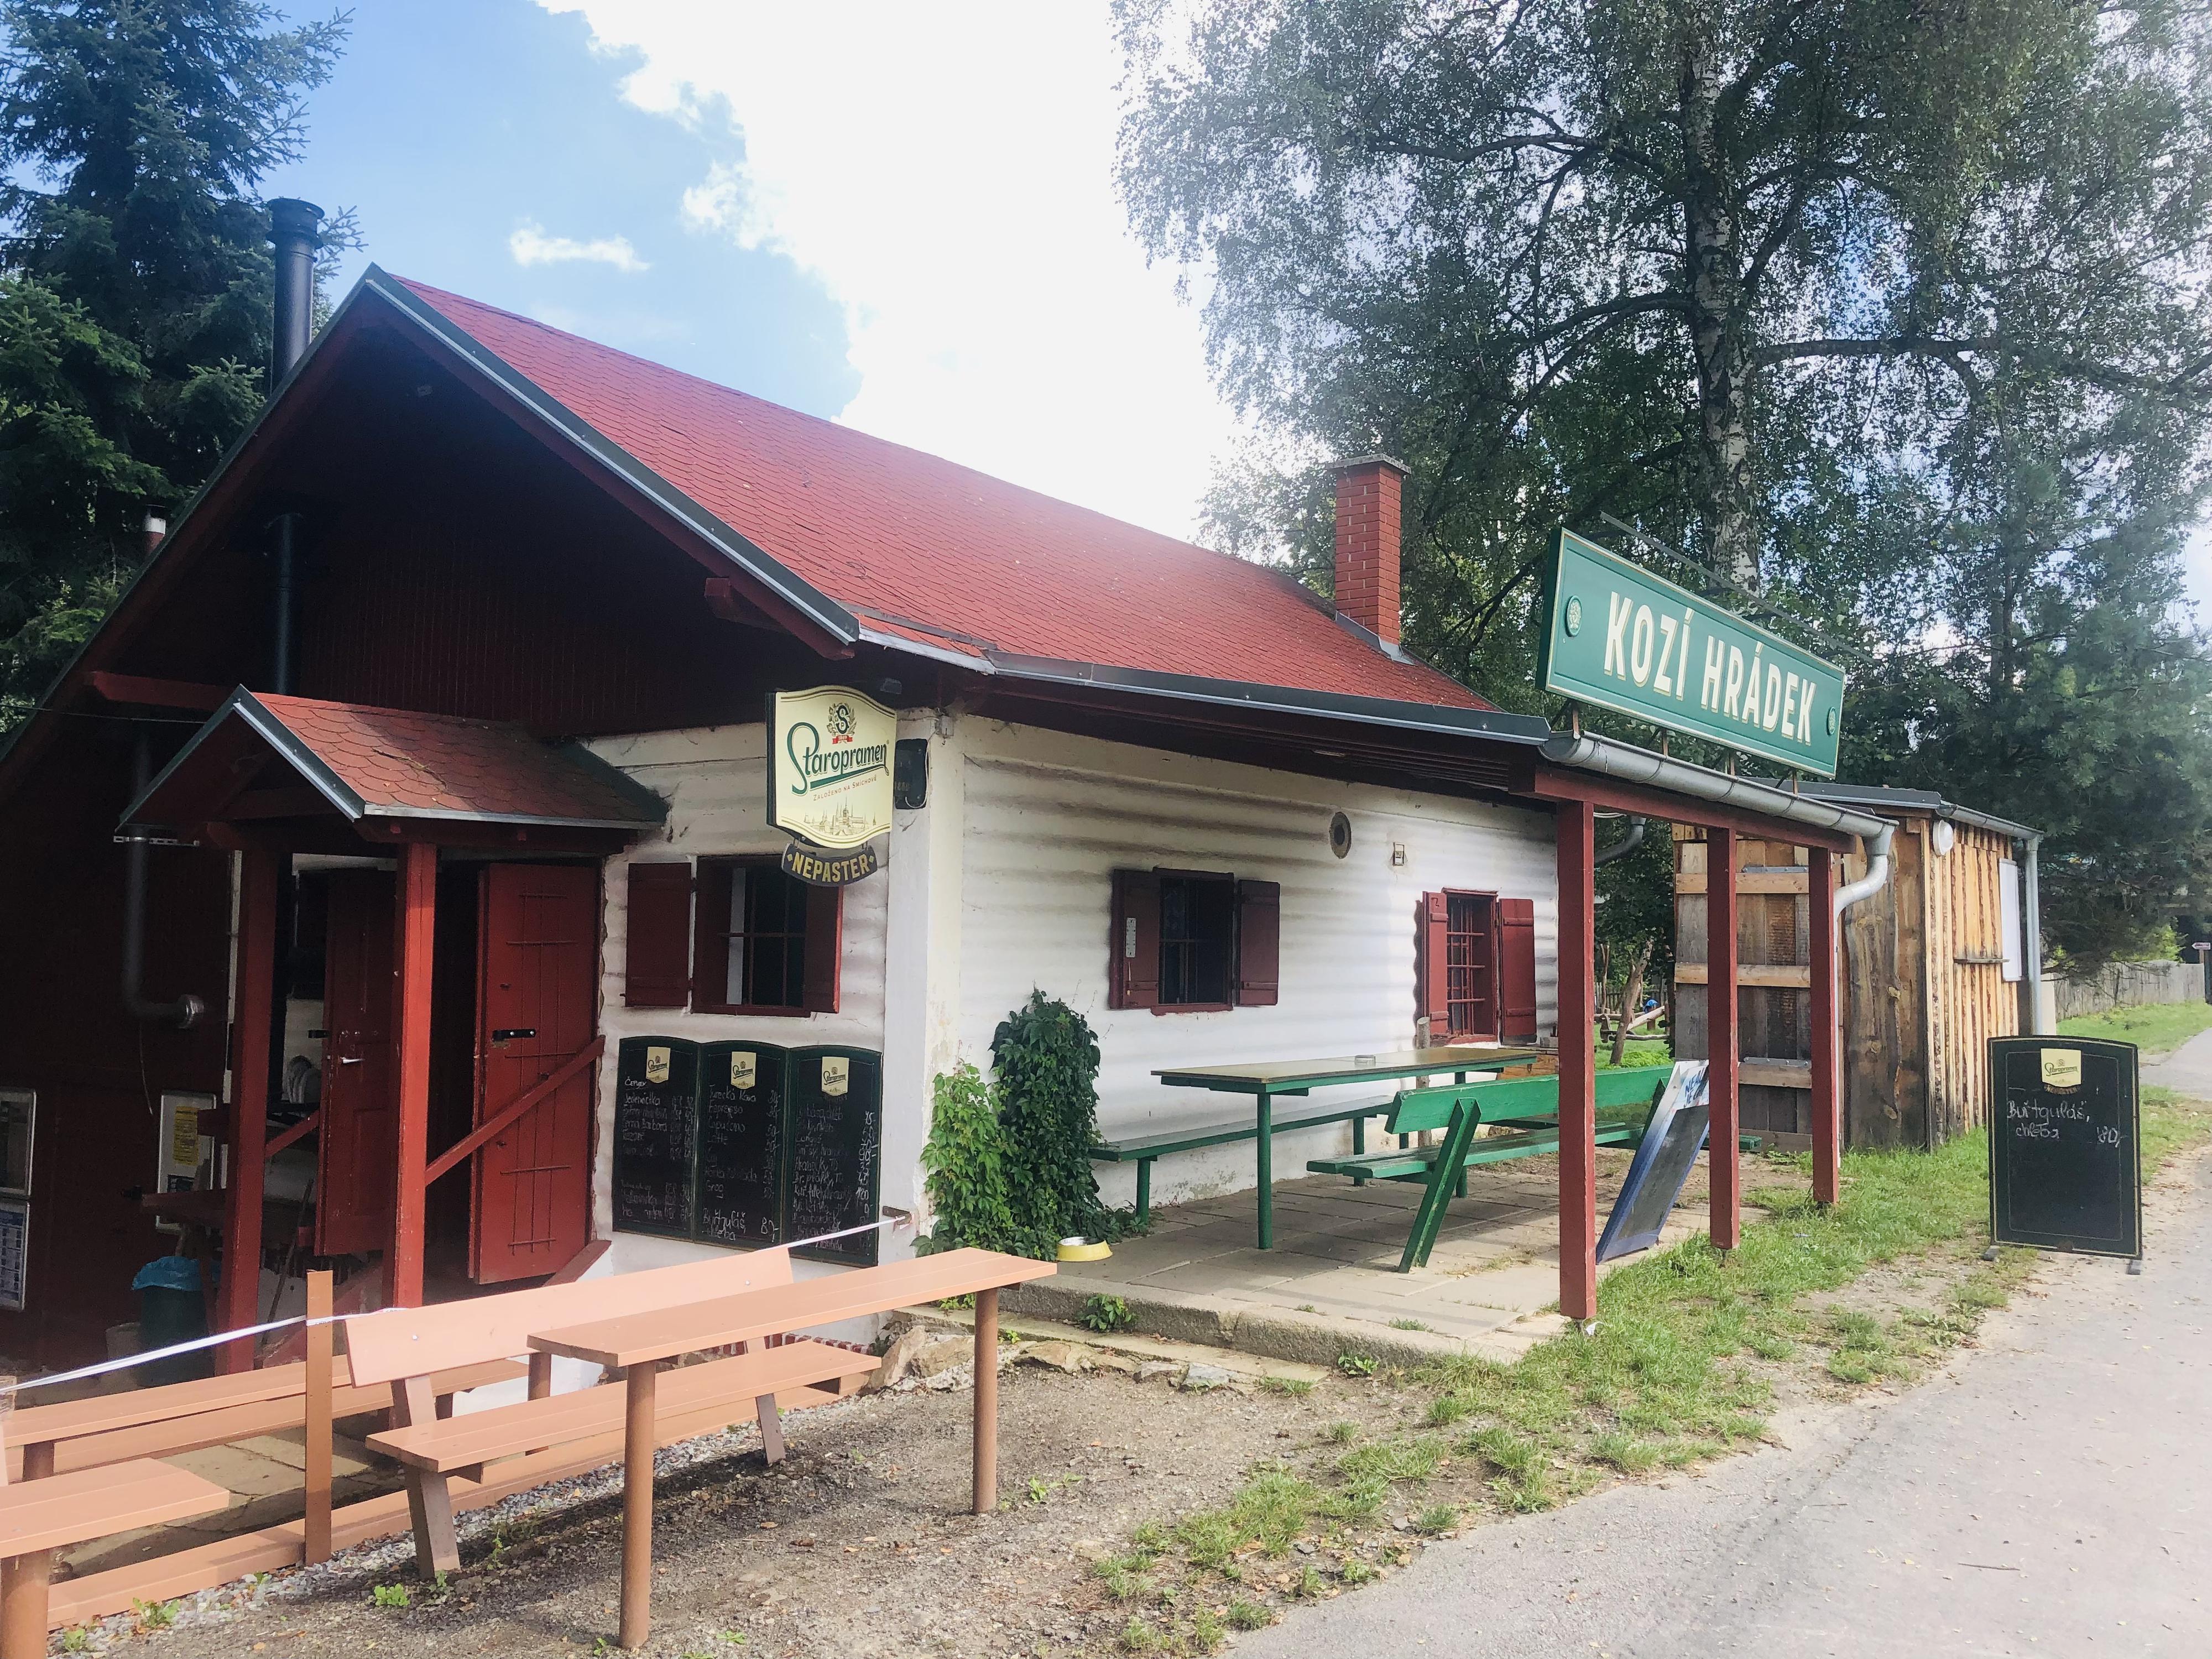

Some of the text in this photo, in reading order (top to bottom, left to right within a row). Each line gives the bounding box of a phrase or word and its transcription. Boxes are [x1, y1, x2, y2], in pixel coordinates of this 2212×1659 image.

[1604, 591, 1817, 746] KOZÍ HRÁDEK
[787, 722, 889, 795] Staropramen
[813, 788, 842, 801] ZALOŽENO
[791, 852, 870, 883] NEPASTER
